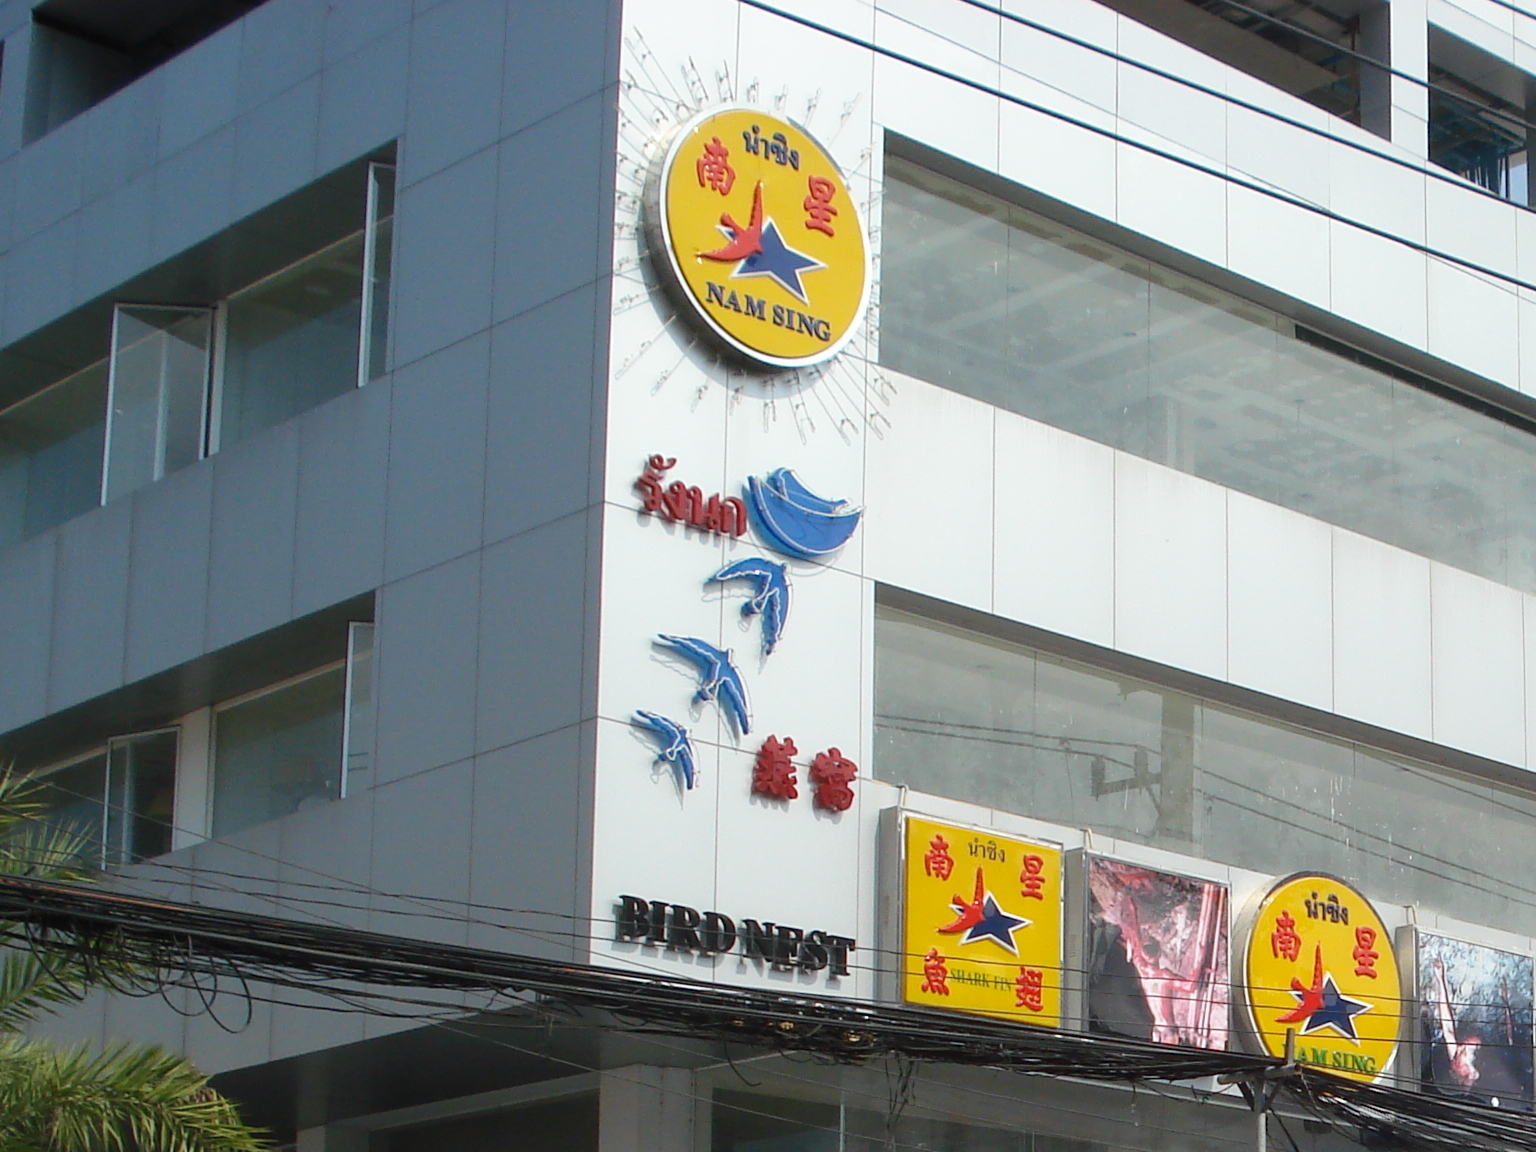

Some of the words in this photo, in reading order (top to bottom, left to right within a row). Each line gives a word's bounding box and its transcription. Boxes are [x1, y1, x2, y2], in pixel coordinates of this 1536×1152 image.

[696, 136, 736, 196] 南
[804, 175, 838, 237] 星
[705, 281, 765, 322] NAM
[772, 306, 832, 343] SING
[637, 454, 747, 537] รังนก
[924, 834, 954, 881] 南
[1020, 854, 1046, 900] 星
[618, 893, 736, 955] BIRD
[741, 917, 856, 978] NEST
[1271, 910, 1302, 962] 南
[1352, 926, 1379, 980] 星
[950, 967, 990, 988] SHARK
[993, 976, 1012, 992] FIN
[1282, 1042, 1328, 1067] AM
[1332, 1049, 1377, 1076] SING
